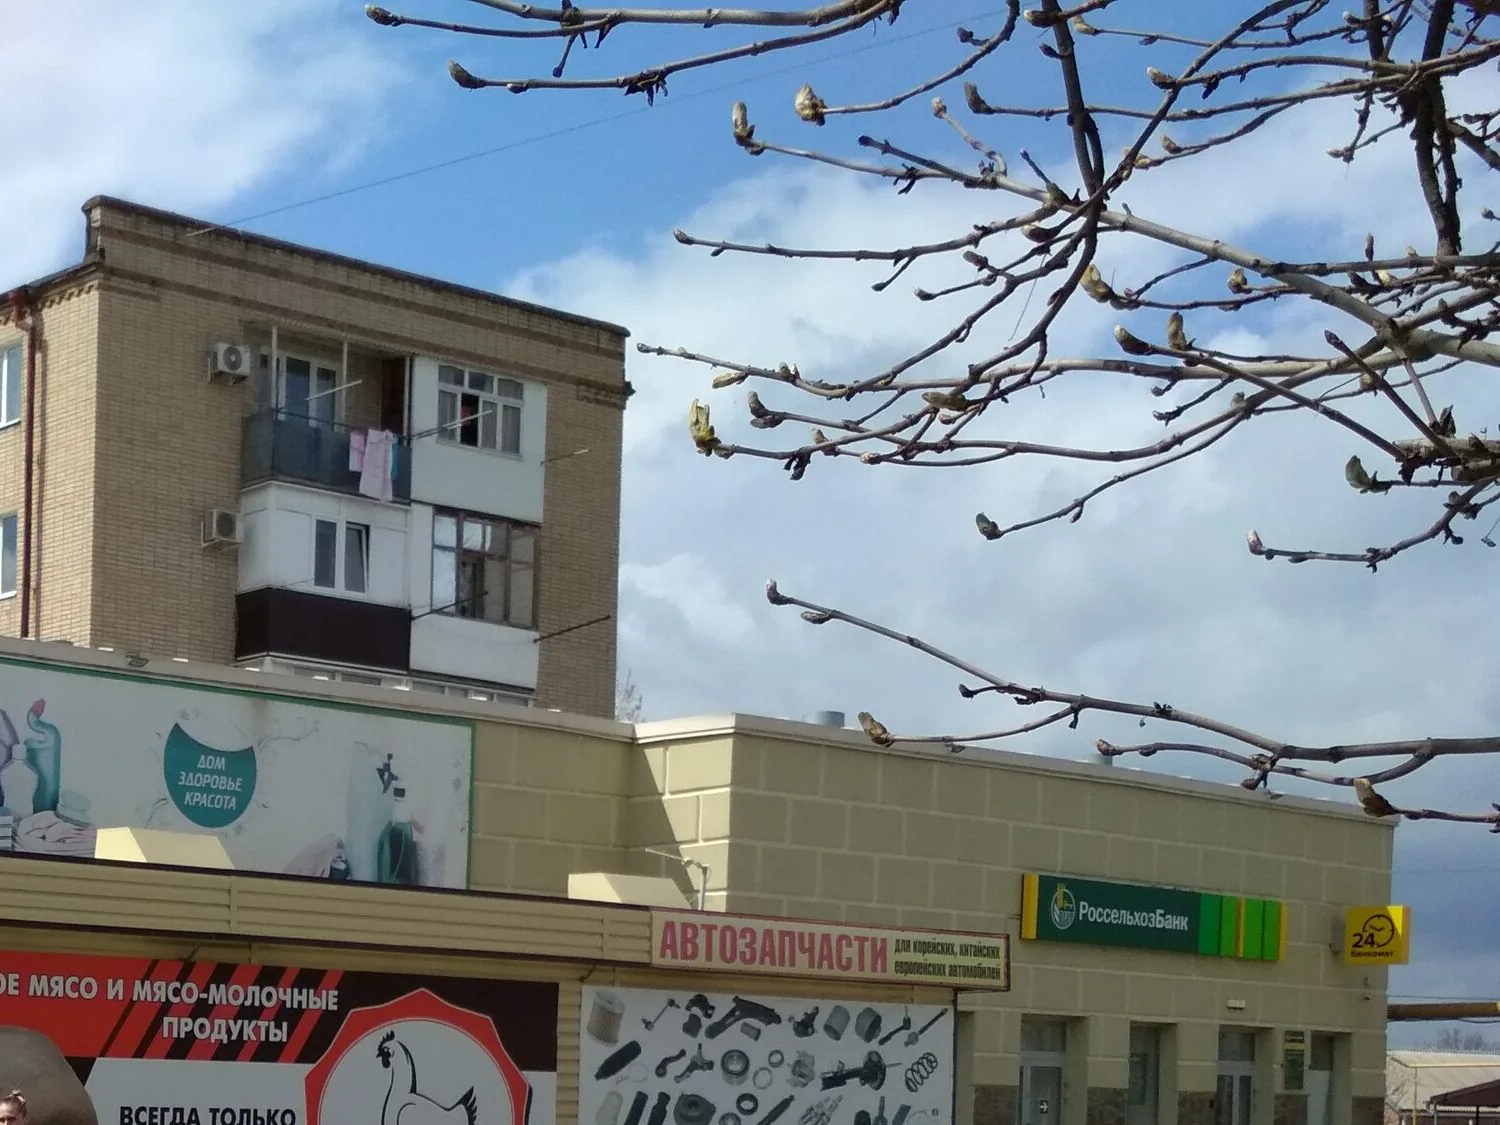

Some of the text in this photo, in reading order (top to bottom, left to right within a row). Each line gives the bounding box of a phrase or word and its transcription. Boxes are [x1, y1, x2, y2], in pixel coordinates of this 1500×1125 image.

[197, 754, 226, 771] ДОМ
[178, 771, 243, 792] ЗДОРОВЬЕ
[184, 791, 237, 811] КРАСОТА
[1078, 900, 1189, 931] РоссельхозБанк
[659, 920, 888, 974] АВТОЗАПЧАСТИ
[1351, 932, 1376, 949] 24
[28, 973, 98, 1000] МЯСО
[107, 978, 124, 1001] И
[131, 979, 339, 1011] МЯСО-МОЛОЧНЫЕ
[162, 1016, 288, 1043] ПРОДУКТЫ
